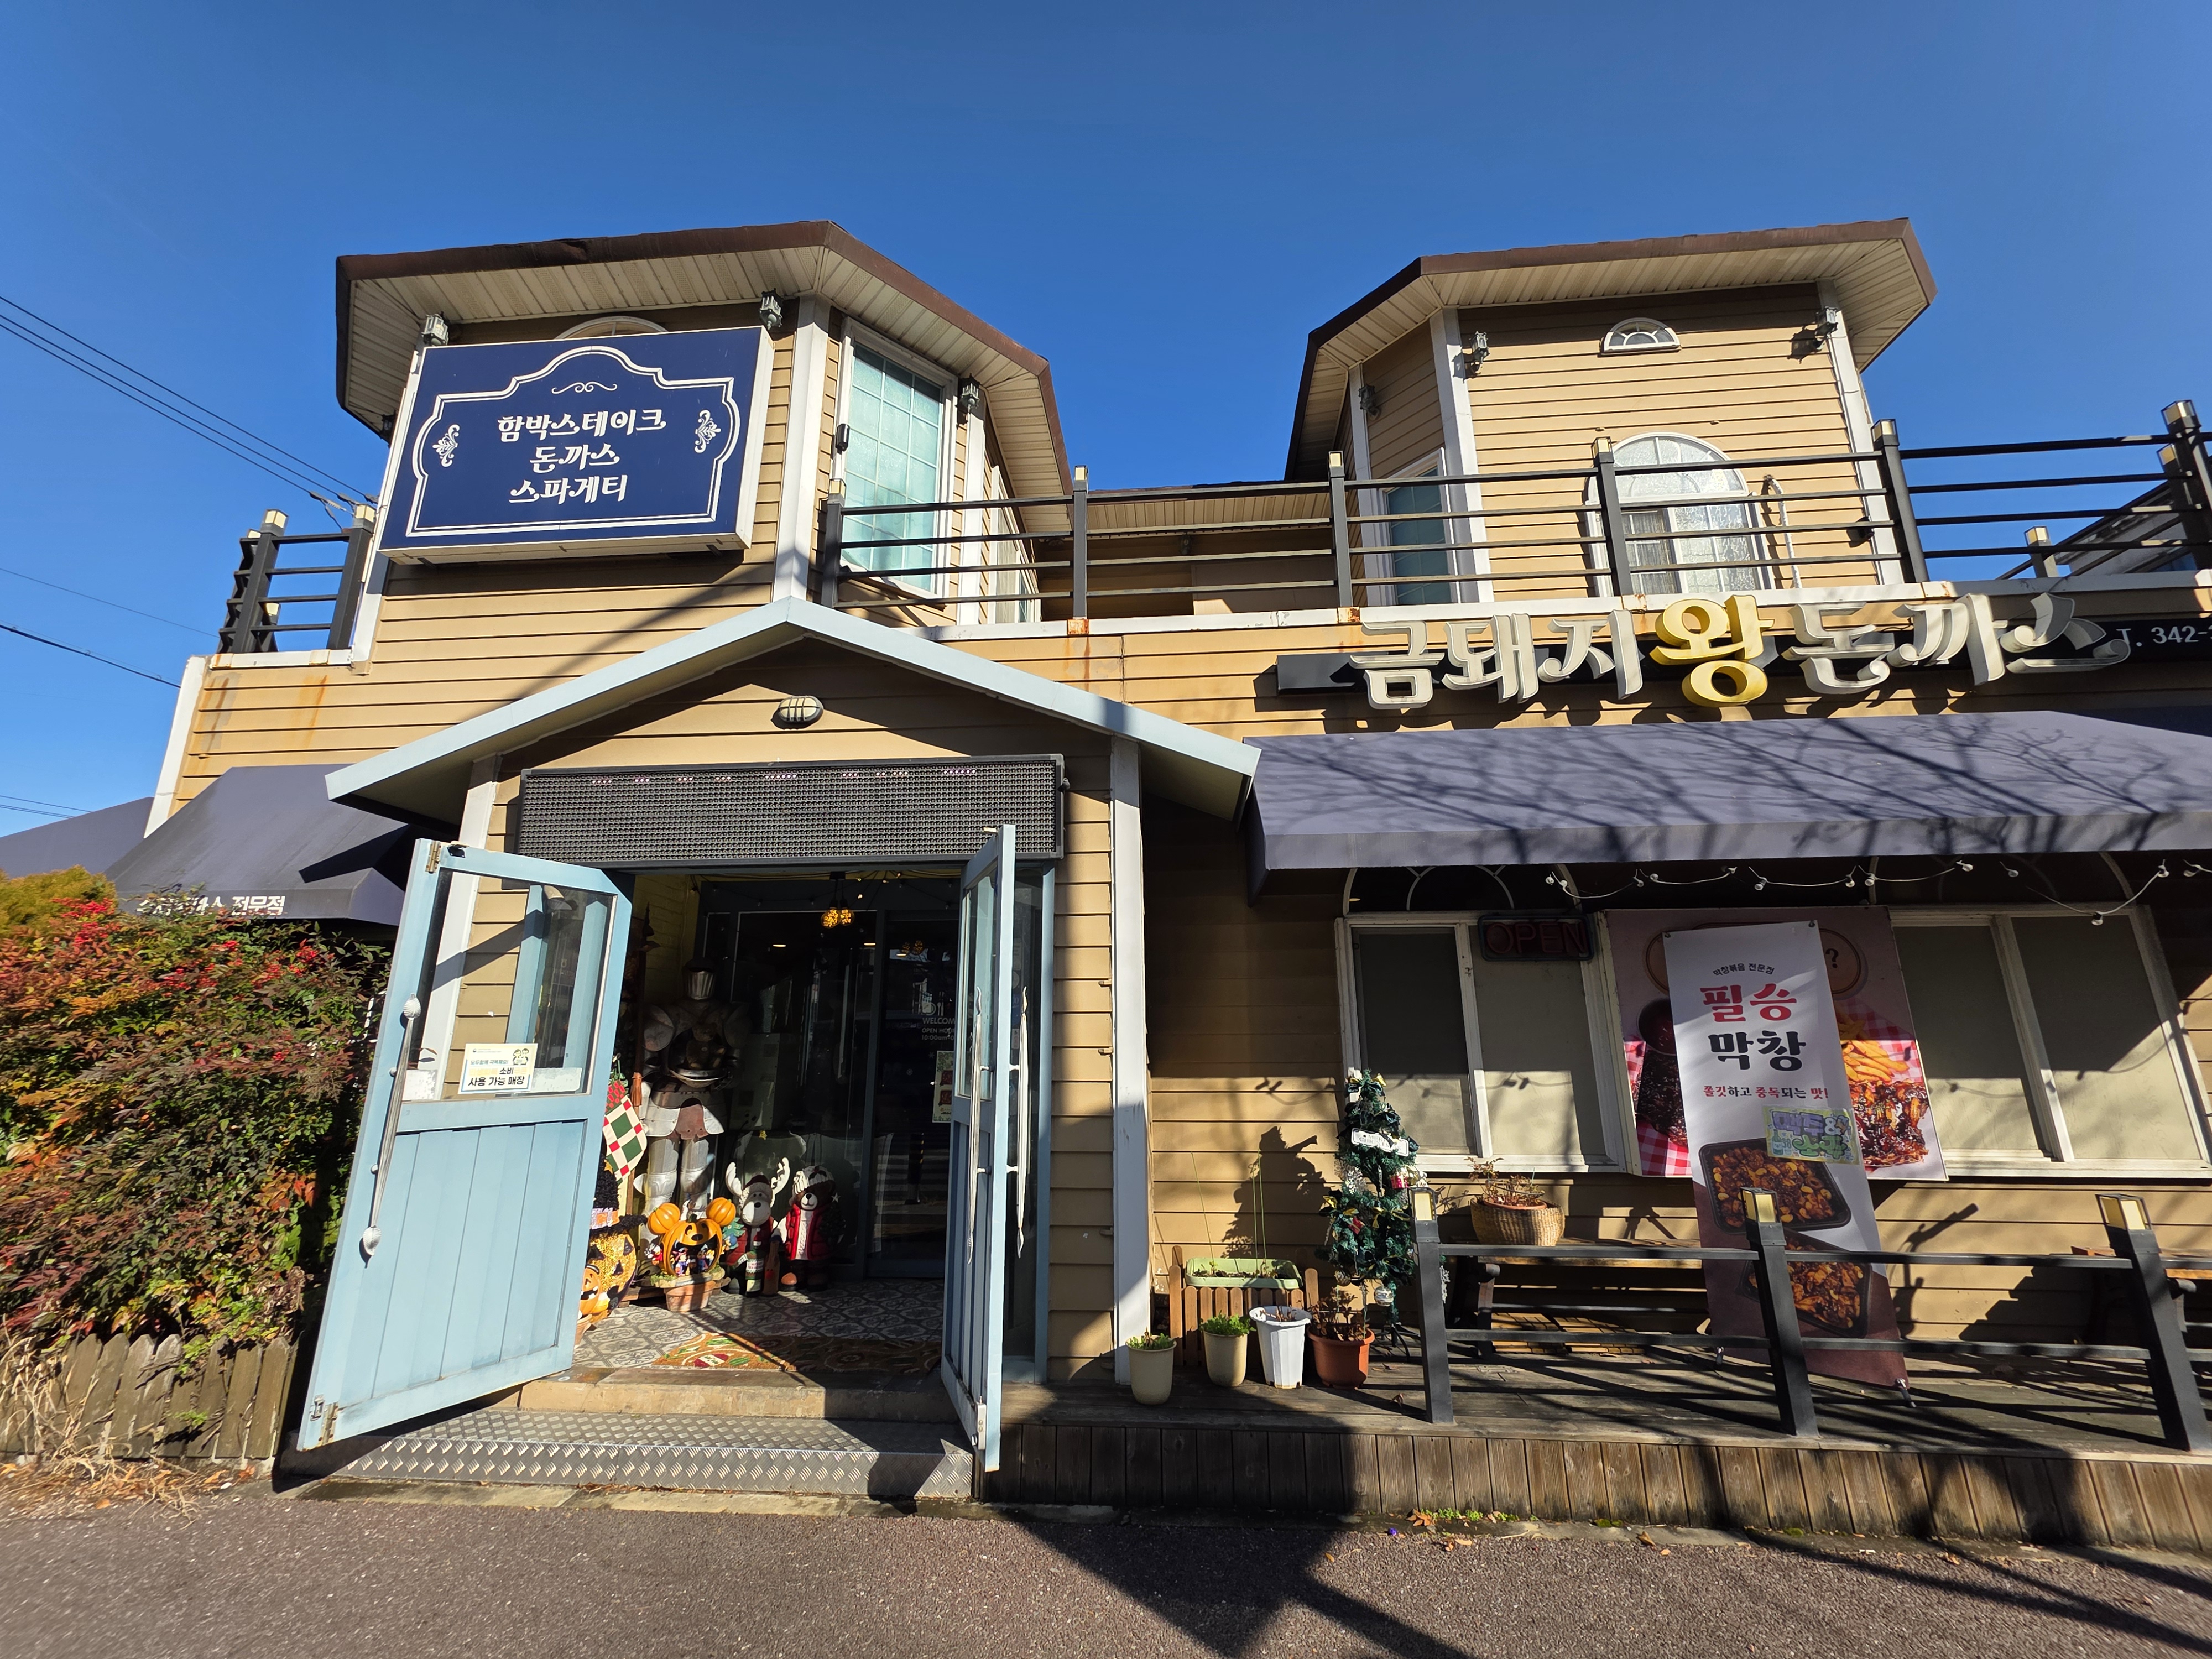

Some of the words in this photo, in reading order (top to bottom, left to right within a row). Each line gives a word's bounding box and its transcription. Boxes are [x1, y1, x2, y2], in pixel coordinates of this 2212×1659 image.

[497, 409, 667, 442] 함박스테이크
[529, 442, 620, 473] 돈까스
[508, 474, 628, 505] 스파게티
[2151, 624, 2212, 644] 342-
[1349, 592, 2131, 709] 금돼지왕돈까스
[1486, 921, 1589, 954] OPEN
[1713, 963, 1745, 976] 막창볶음
[1748, 963, 1775, 975] 전문점
[1699, 983, 1797, 1022] 필승
[1708, 1030, 1807, 1072] 막창
[468, 1077, 486, 1087] 사용
[488, 1076, 506, 1086] 가능
[508, 1076, 525, 1086] 매장
[1703, 1086, 1752, 1097] 쫄깃하고
[1755, 1087, 1807, 1099] 중독되는
[1810, 1088, 1829, 1100] 맛!
